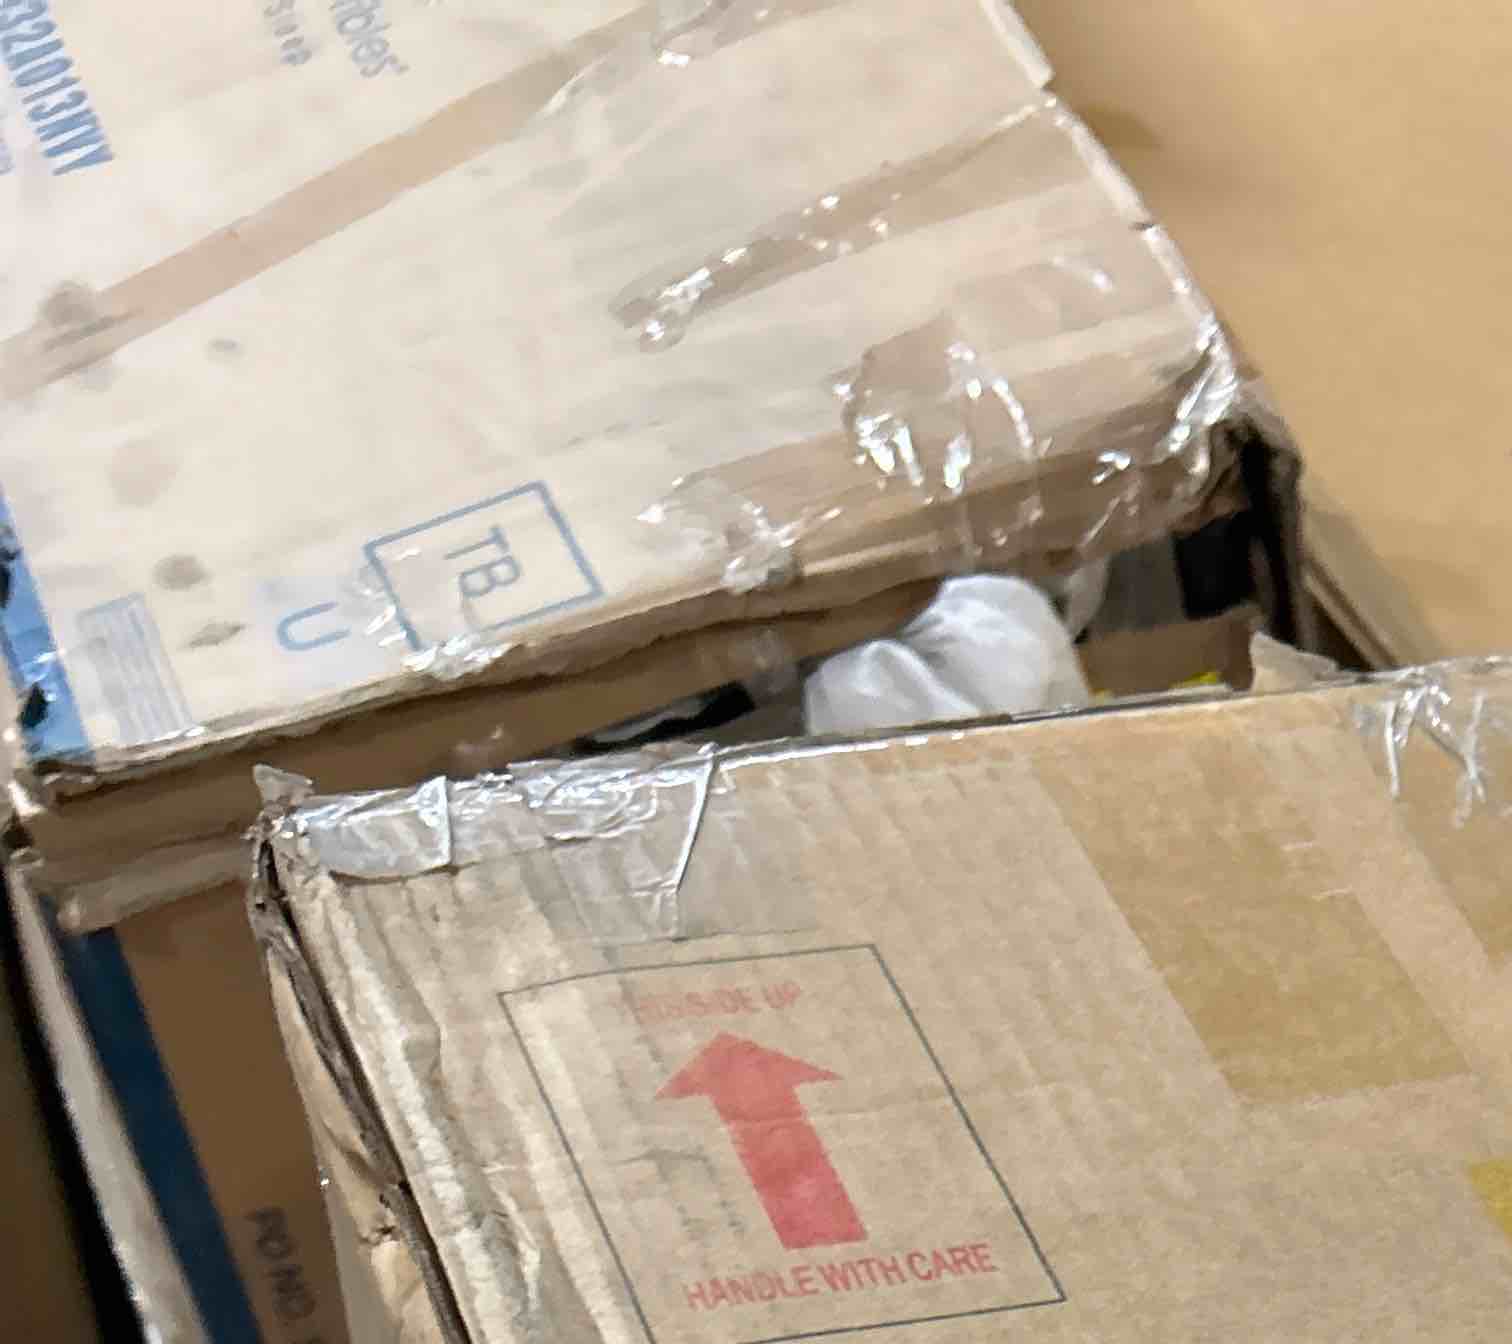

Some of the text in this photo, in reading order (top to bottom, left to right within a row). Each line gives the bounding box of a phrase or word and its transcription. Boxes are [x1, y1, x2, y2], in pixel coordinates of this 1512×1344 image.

[443, 523, 522, 598] TB
[684, 1242, 1000, 1312] HANDLE WITH CARE
